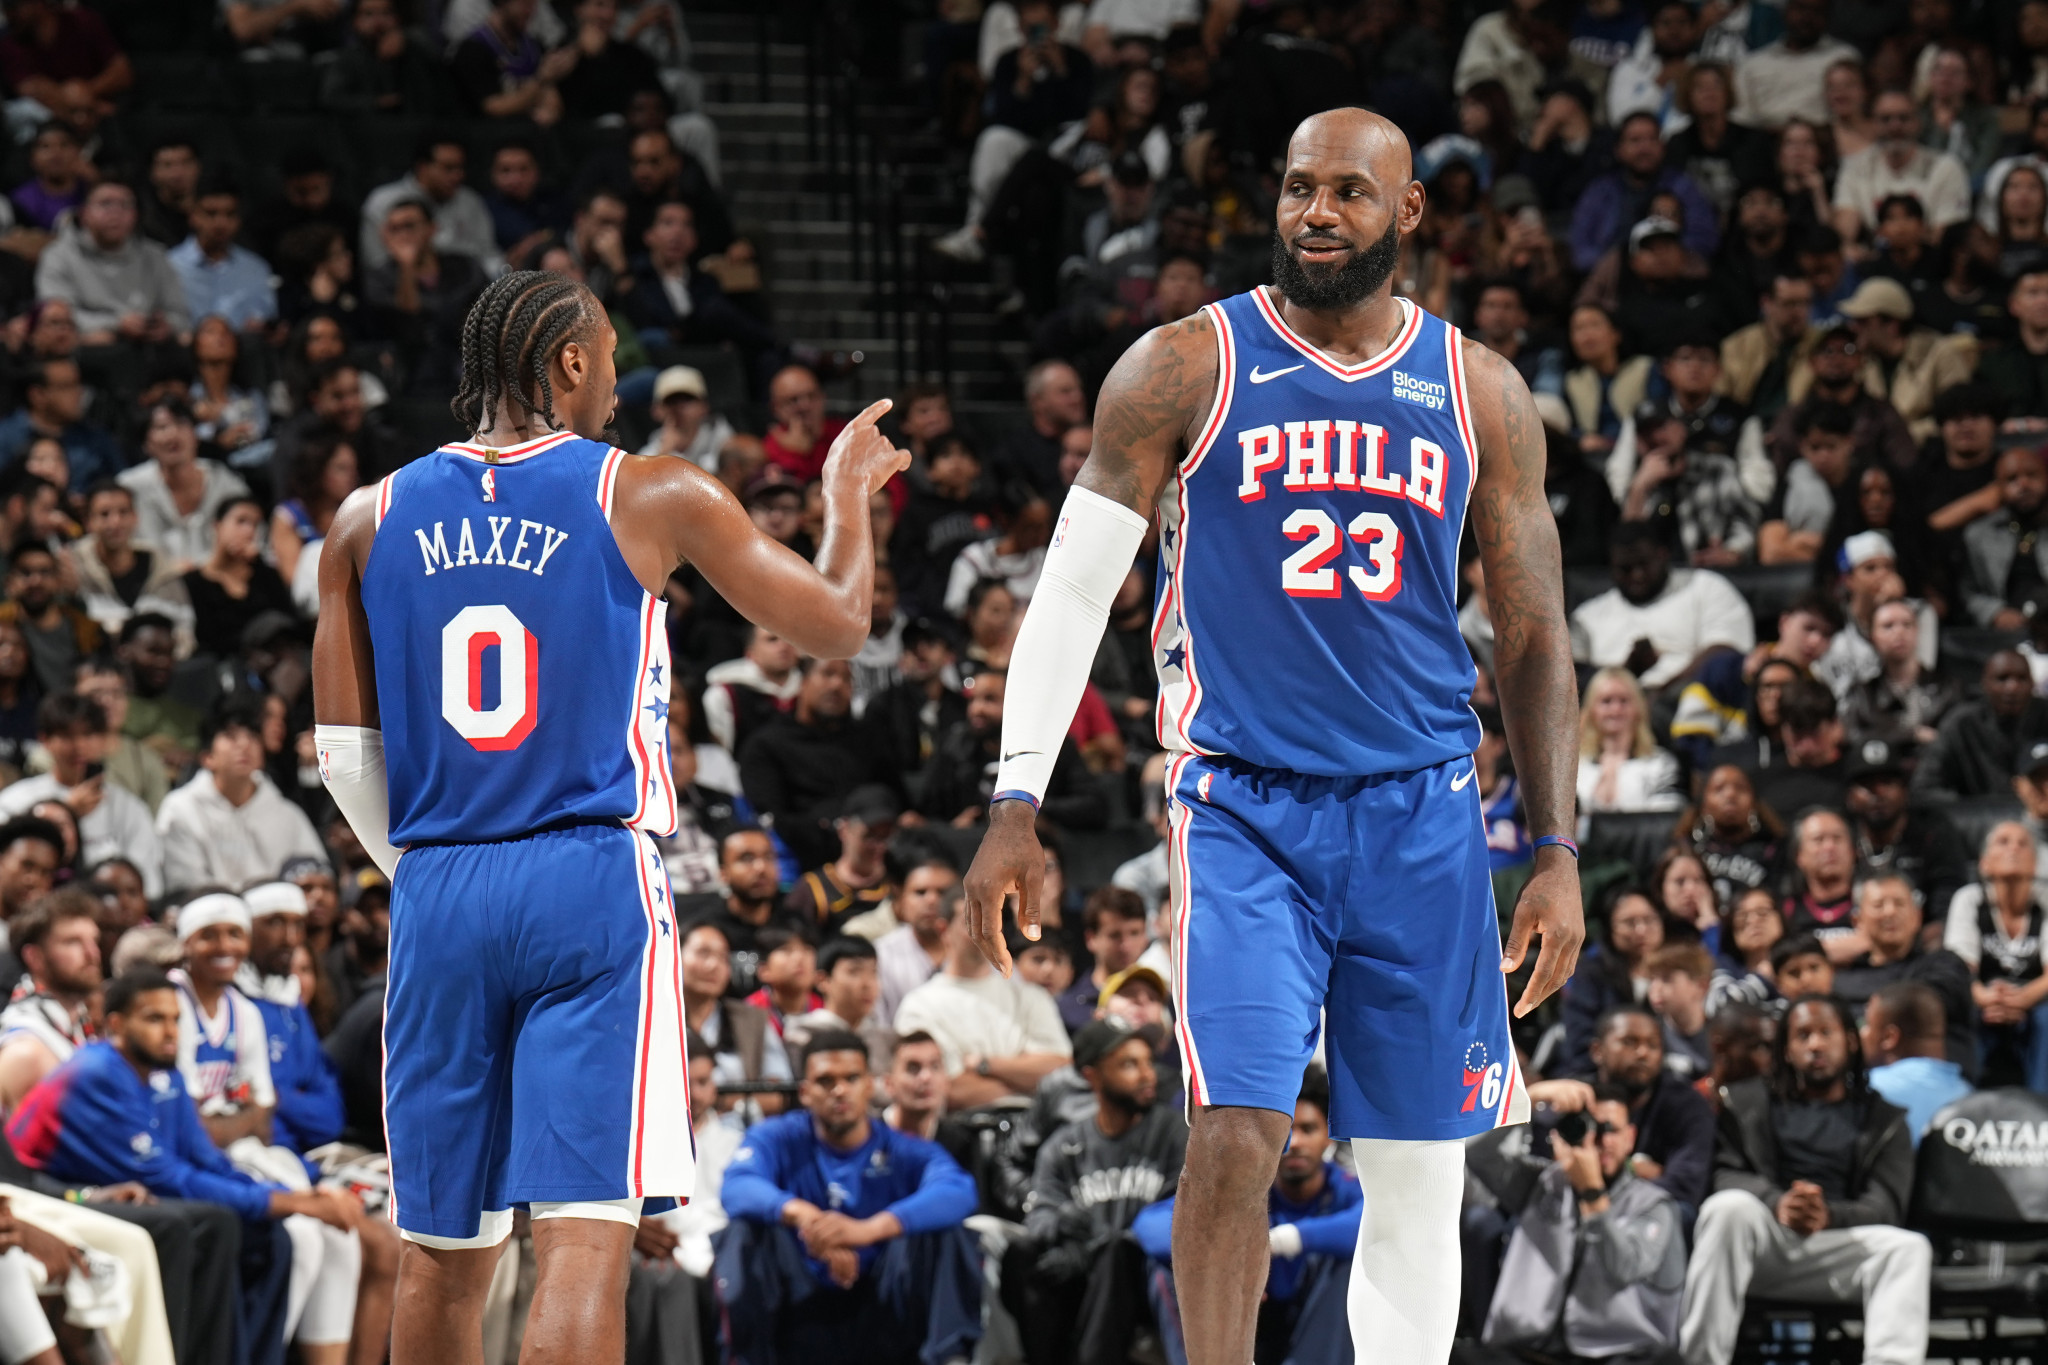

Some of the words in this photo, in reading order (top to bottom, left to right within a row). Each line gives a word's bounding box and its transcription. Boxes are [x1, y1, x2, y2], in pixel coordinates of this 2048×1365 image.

[1392, 370, 1446, 397] Bloom
[1393, 386, 1446, 410] energy
[1238, 419, 1449, 520] PHILA
[414, 515, 569, 577] MAXEY
[1282, 508, 1405, 602] 23
[442, 604, 539, 752] 0
[1460, 1062, 1503, 1113] 76
